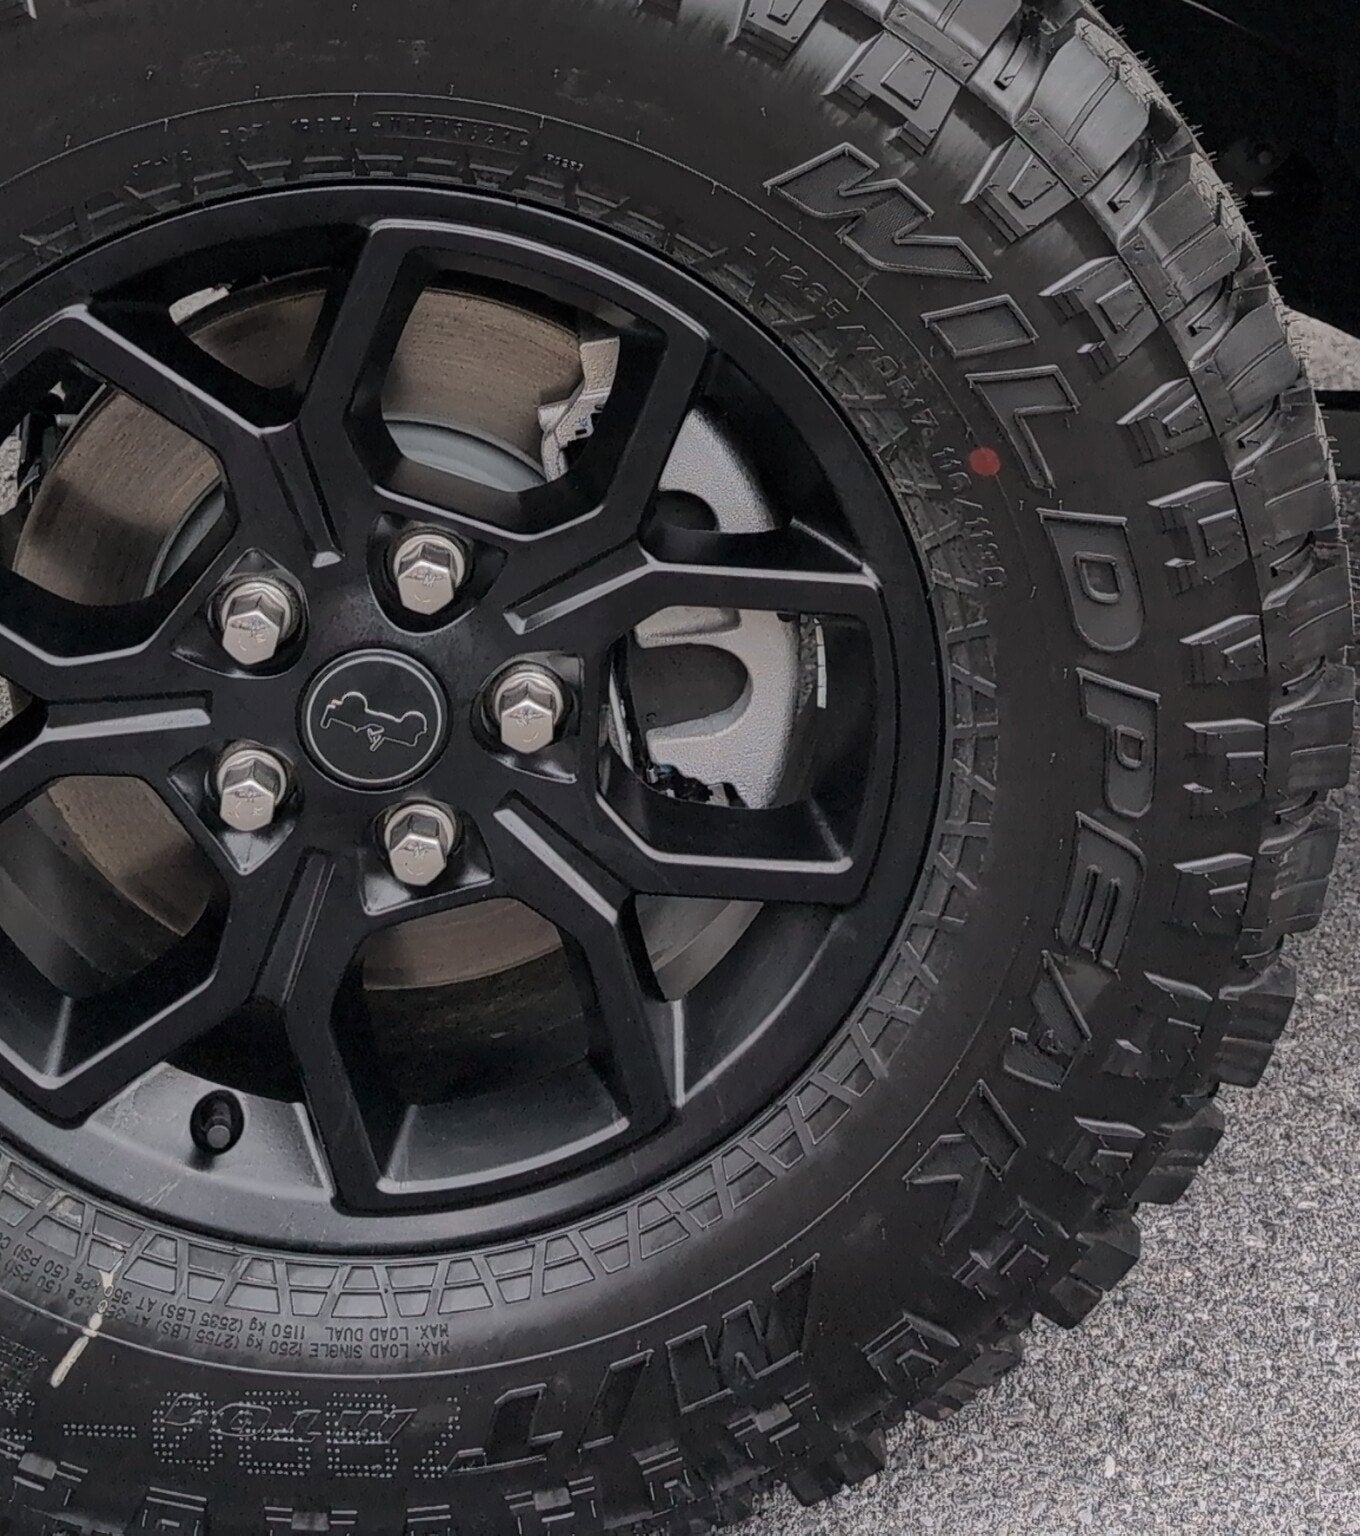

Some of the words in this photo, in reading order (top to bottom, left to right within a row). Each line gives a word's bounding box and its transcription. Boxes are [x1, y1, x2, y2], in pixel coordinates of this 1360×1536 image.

[762, 141, 1162, 1248] WILDPEAK
[131, 1292, 158, 1315] AT
[157, 1298, 198, 1327] LBS)
[126, 1308, 152, 1330] AT
[152, 1314, 193, 1342] LBS)
[268, 1321, 306, 1342] 1150
[322, 1325, 364, 1344] DUAL
[370, 1324, 409, 1343] LOAD
[414, 1321, 450, 1341] MAX.
[265, 1337, 303, 1359] 1250
[307, 1340, 362, 1359] SINGLE
[370, 1341, 410, 1359] LOAD
[415, 1336, 452, 1356] MAX.
